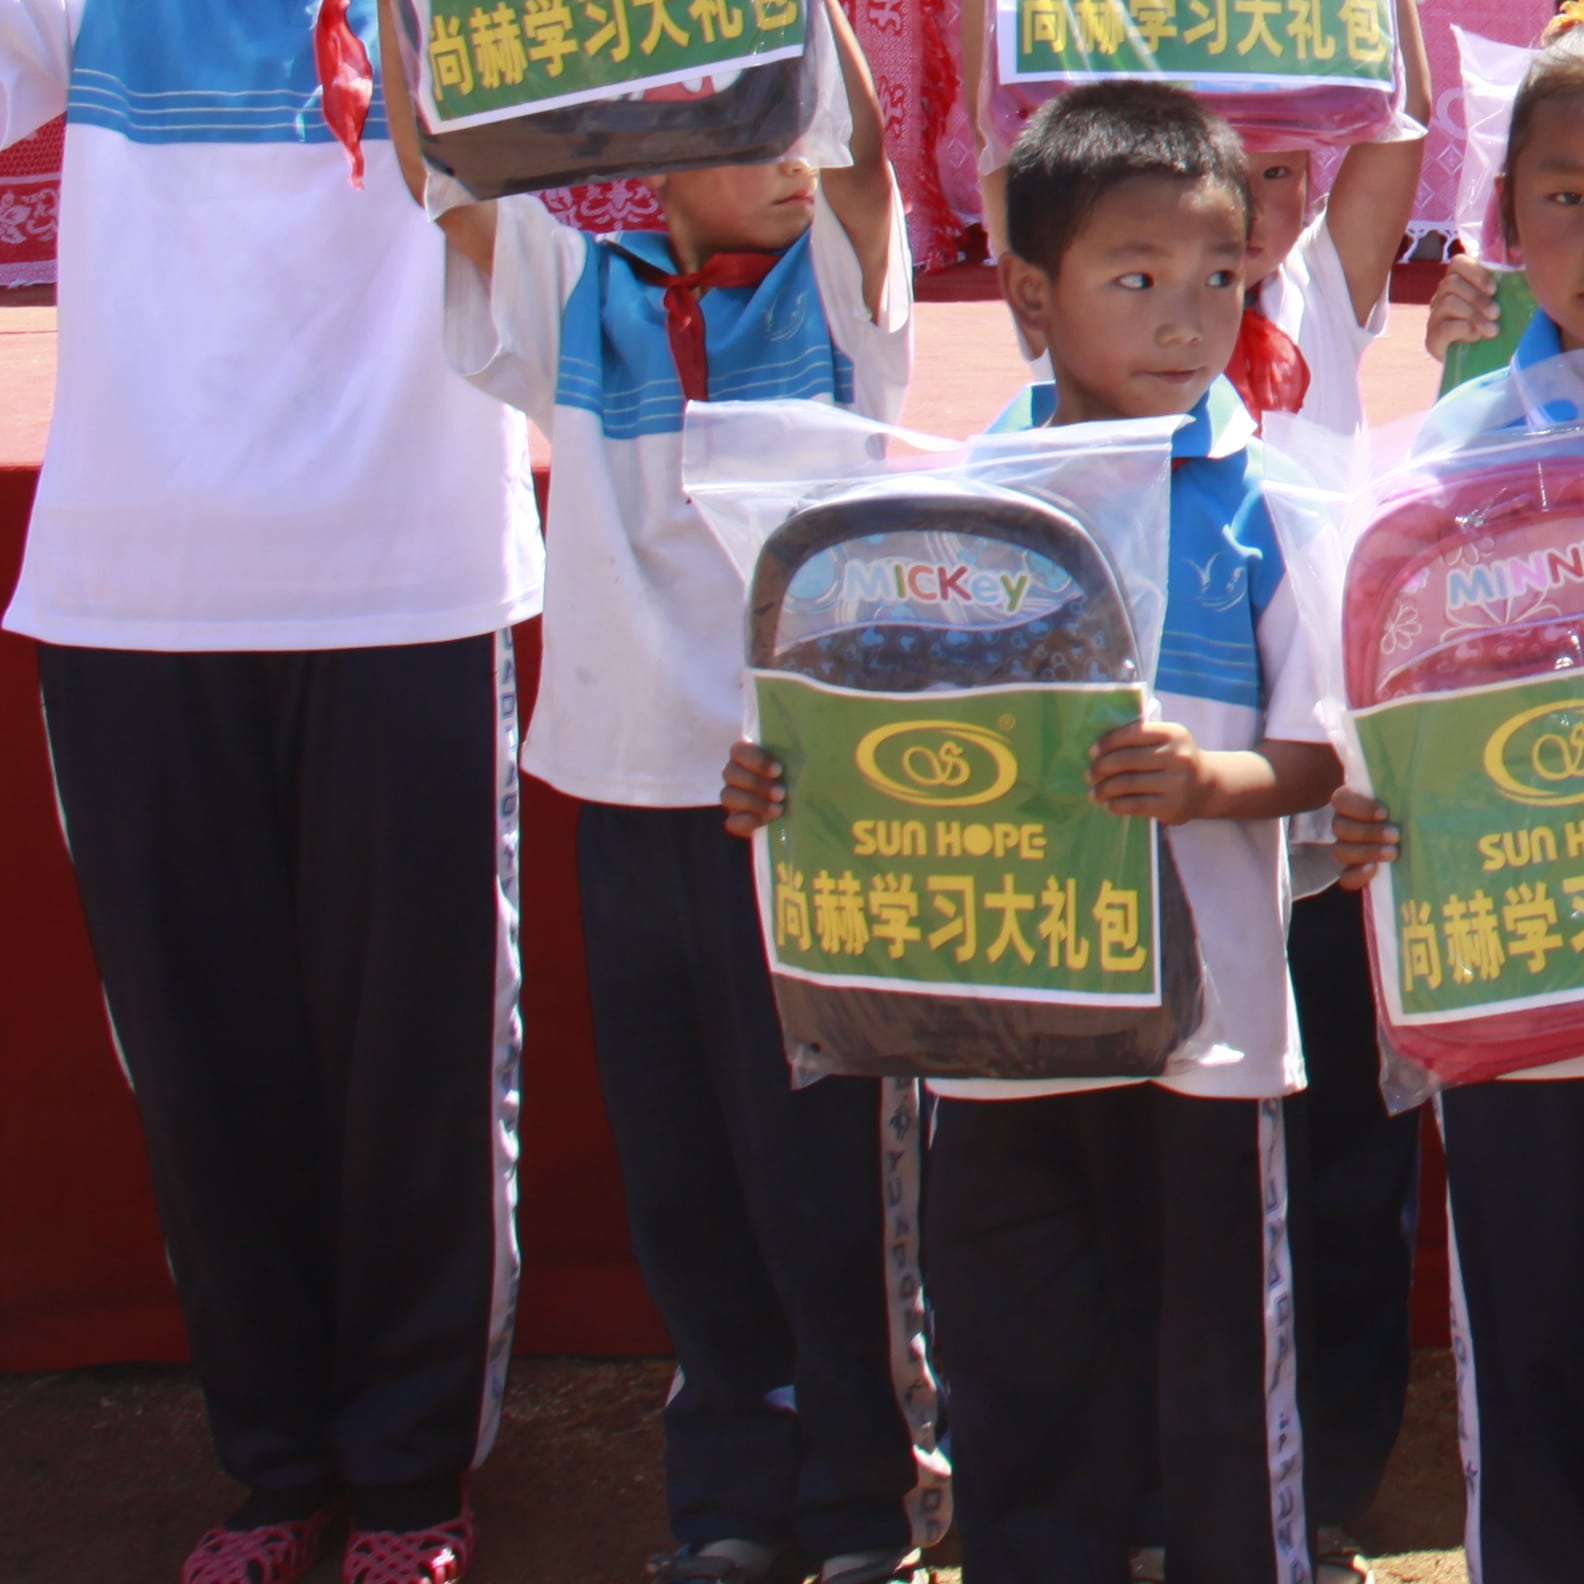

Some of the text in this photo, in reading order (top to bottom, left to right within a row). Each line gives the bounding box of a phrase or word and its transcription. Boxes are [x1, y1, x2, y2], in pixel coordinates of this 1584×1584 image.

[851, 819, 1047, 861] SUN HOPE
[1479, 827, 1558, 871] SUN
[774, 870, 1146, 974] 尚赫学习大礼包
